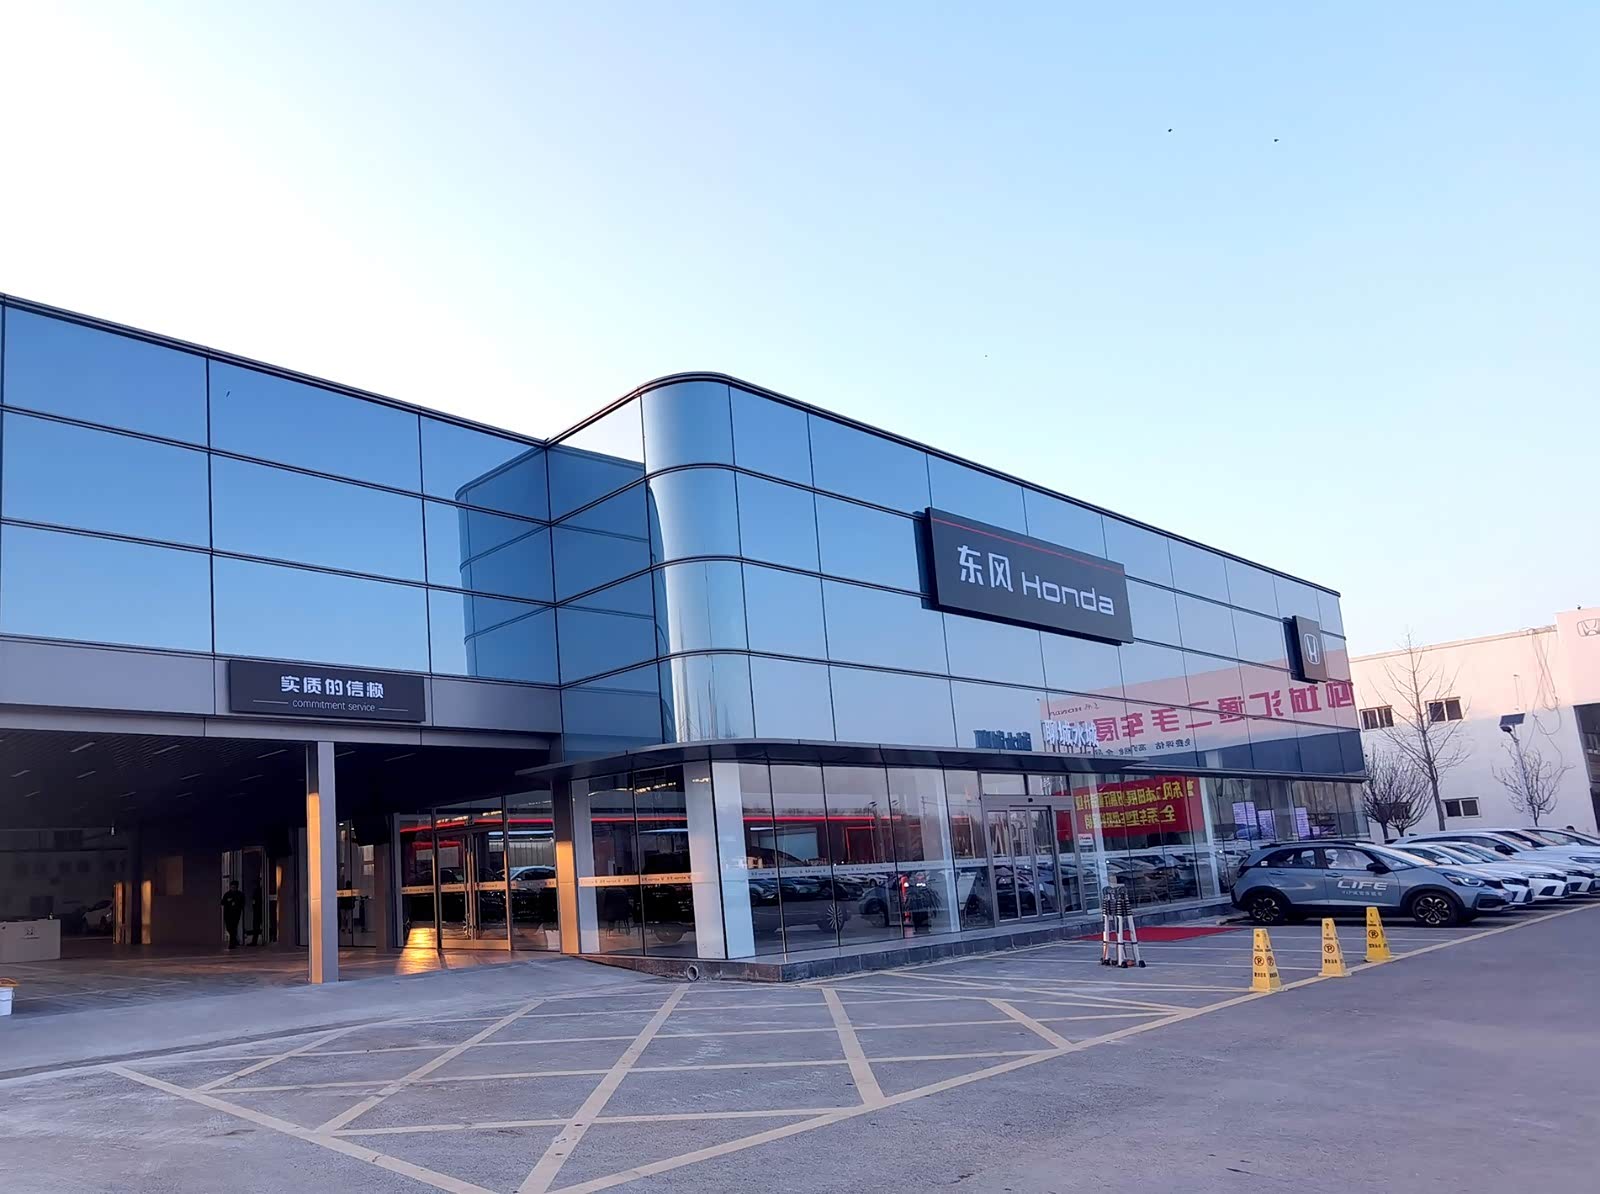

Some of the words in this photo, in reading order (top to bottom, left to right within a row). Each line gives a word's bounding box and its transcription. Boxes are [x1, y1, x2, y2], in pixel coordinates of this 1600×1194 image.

[957, 545, 1013, 592] 东风
[1022, 572, 1115, 616] Honda
[281, 676, 383, 698] 实质的信赖
[292, 700, 345, 710] commitment
[348, 702, 376, 711] service
[1337, 880, 1389, 891] LIFE
